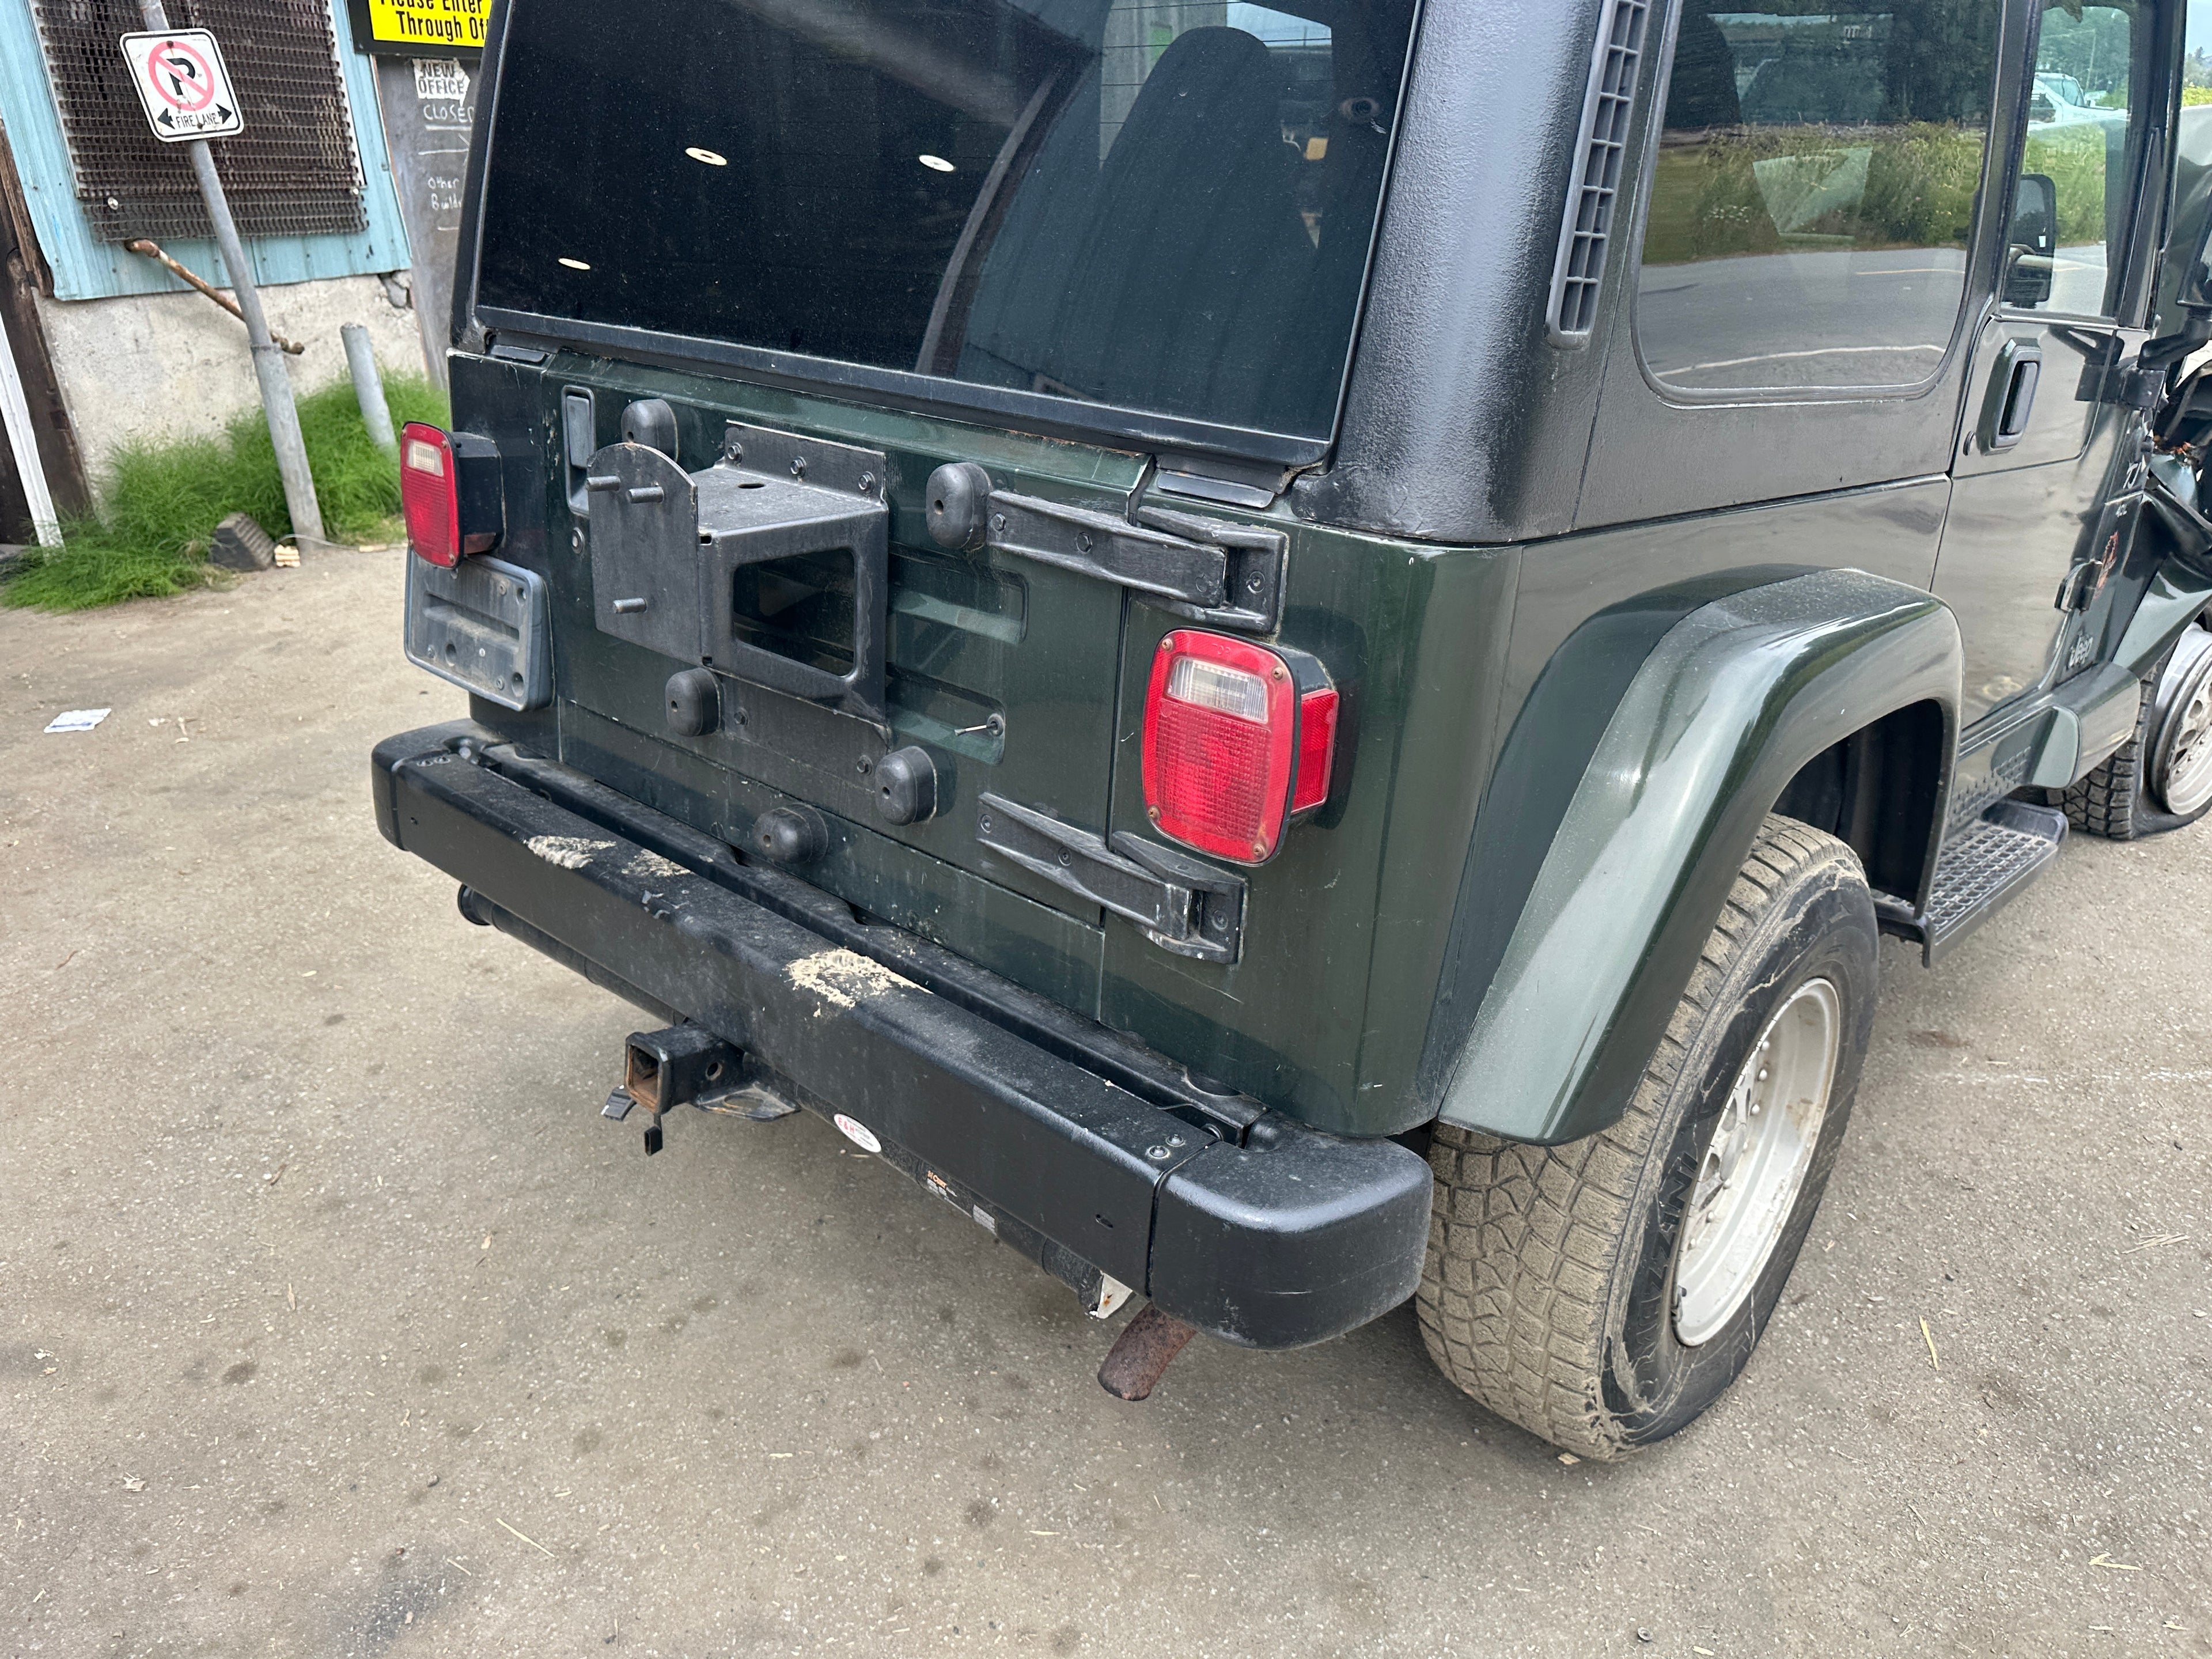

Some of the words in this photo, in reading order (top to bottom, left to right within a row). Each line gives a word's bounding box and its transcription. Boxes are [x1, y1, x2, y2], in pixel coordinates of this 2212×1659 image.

[396, 10, 463, 42] Through
[469, 17, 488, 40] Of
[421, 61, 454, 78] NEW
[418, 75, 464, 95] OFFICE
[175, 115, 196, 128] FIRE
[195, 112, 220, 128] LANE
